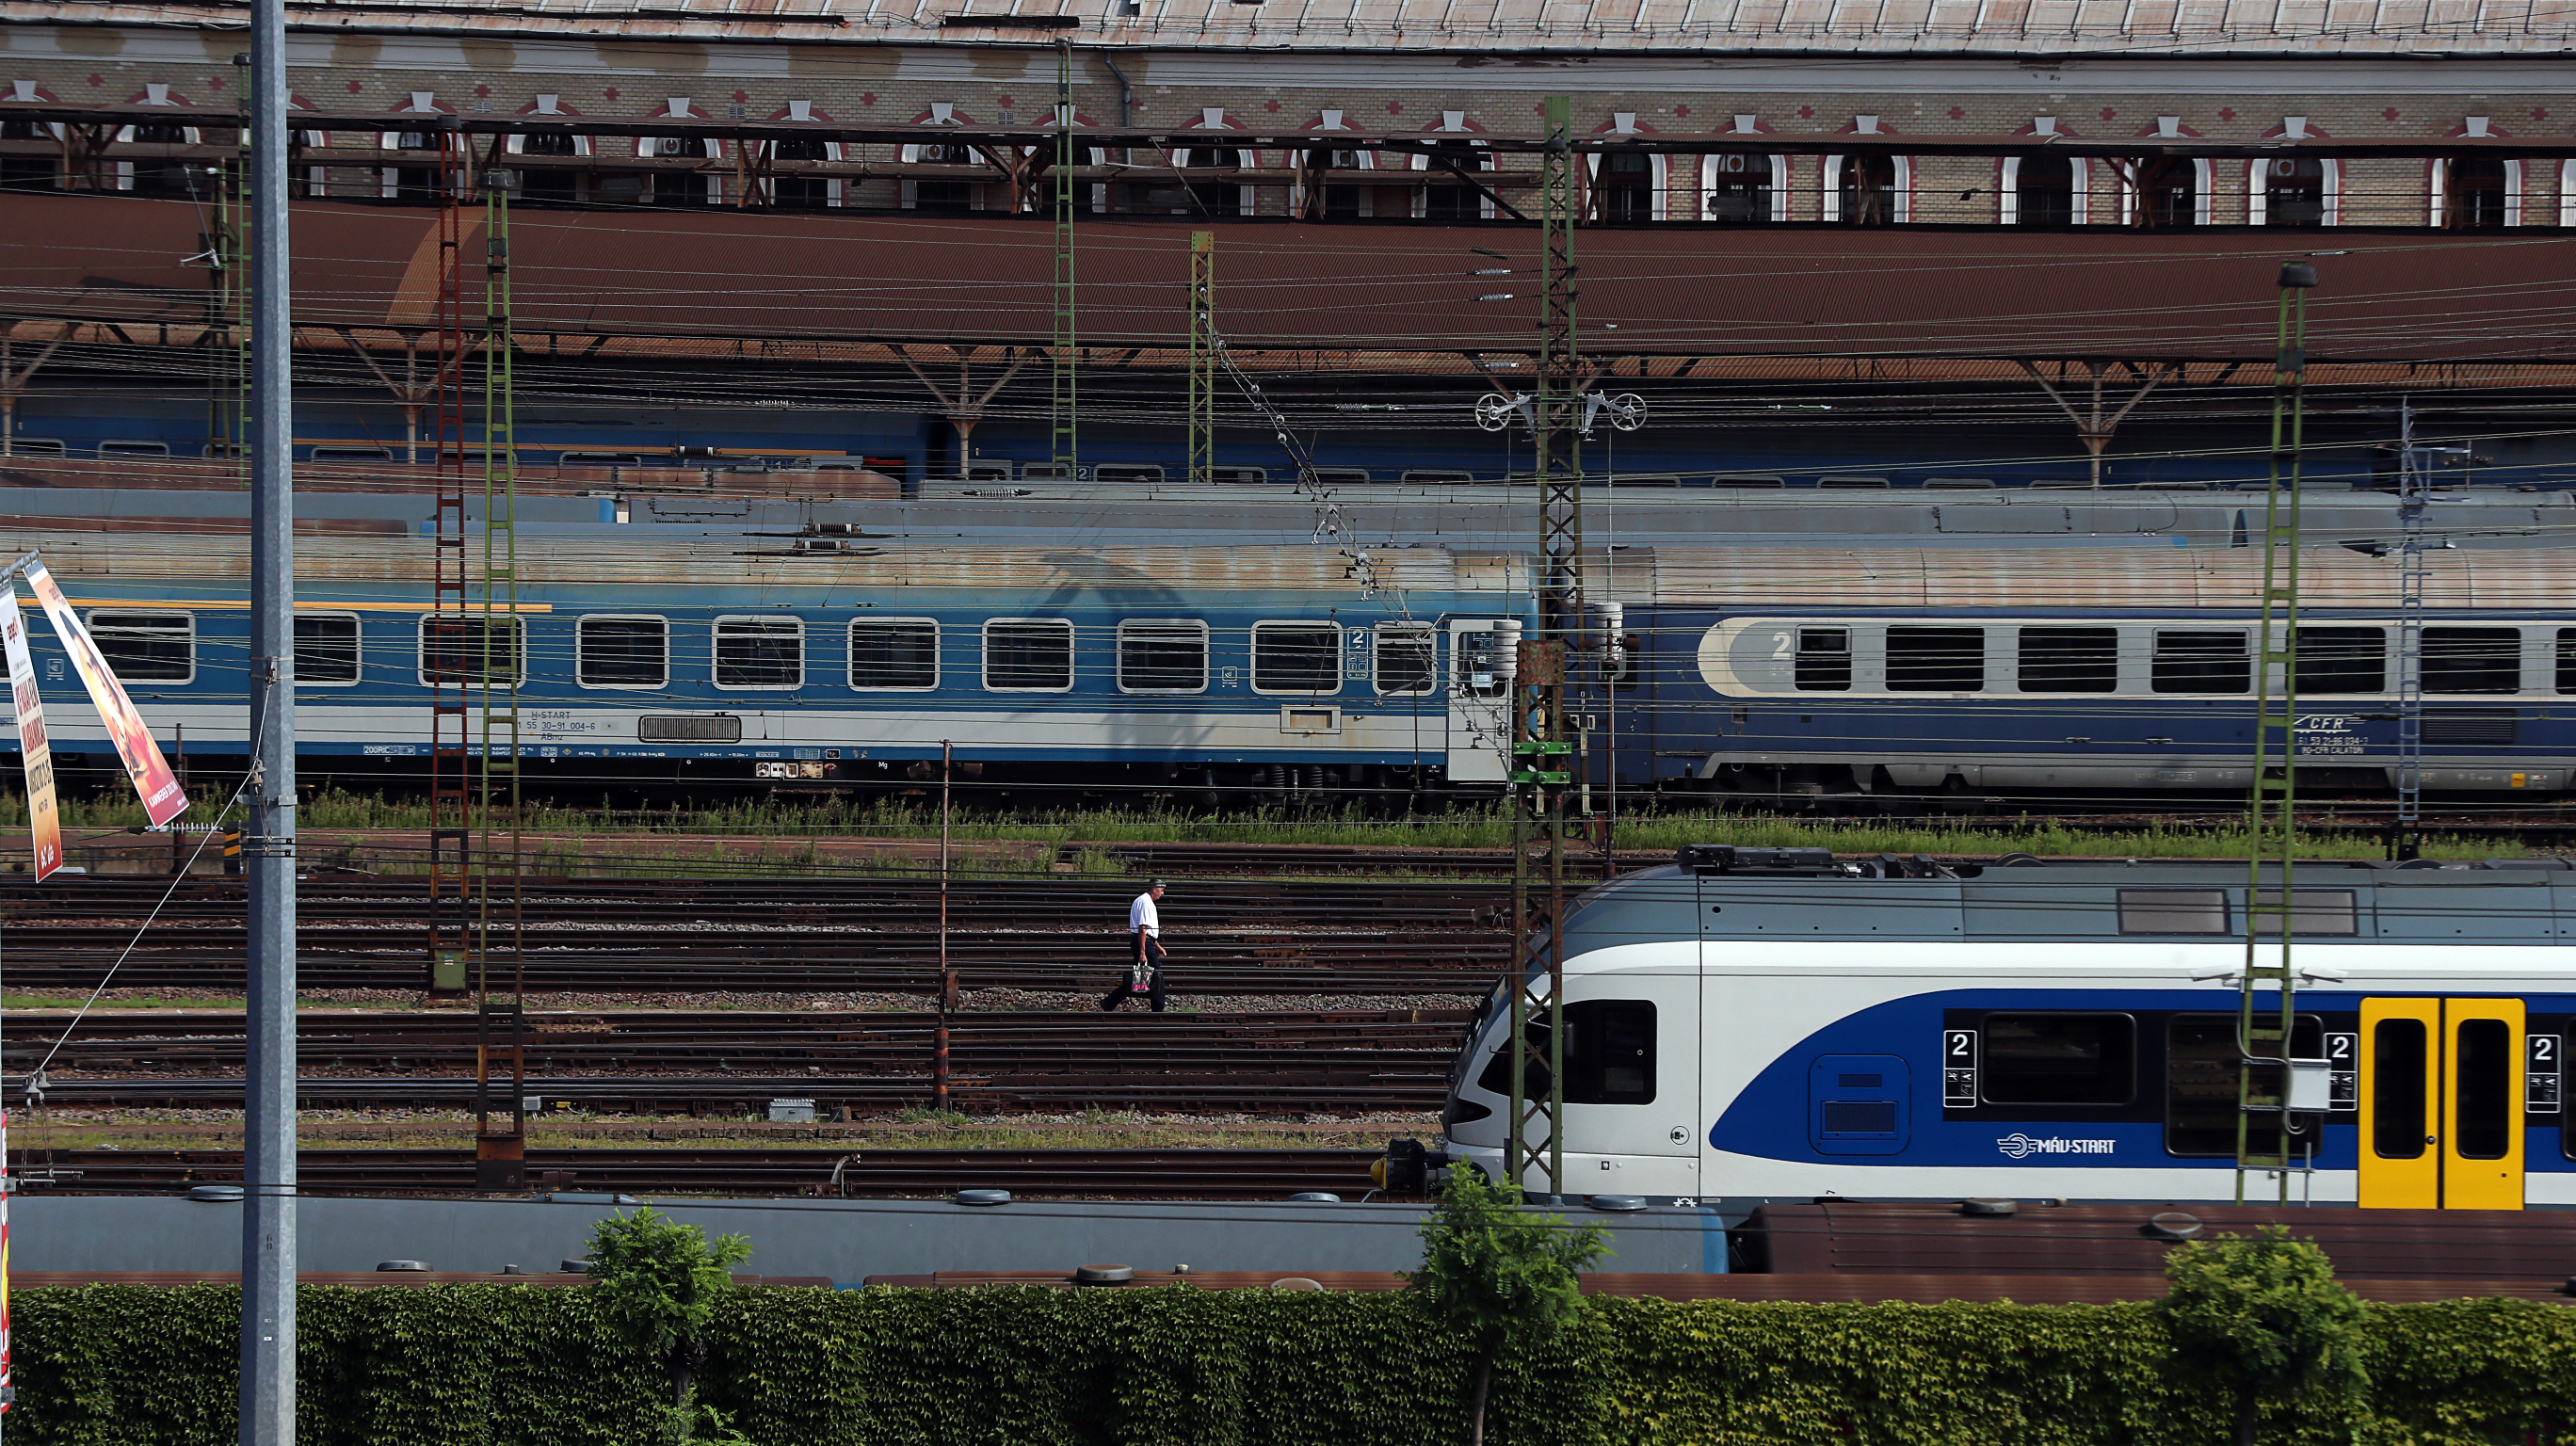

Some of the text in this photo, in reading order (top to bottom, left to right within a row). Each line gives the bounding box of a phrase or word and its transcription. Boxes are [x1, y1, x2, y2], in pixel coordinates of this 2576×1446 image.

[1078, 468, 1087, 480] 2
[1352, 628, 1364, 644] 2
[1771, 632, 1791, 660] 2
[531, 711, 571, 719] H-START
[526, 721, 538, 730] 55
[541, 722, 566, 731] 30-91
[570, 722, 596, 731] 004-6
[2310, 717, 2344, 730] CFR
[2310, 737, 2321, 746] 53
[877, 761, 888, 770] Mg
[1952, 1033, 1969, 1056] 2
[2331, 1036, 2349, 1059] 2
[2535, 1038, 2552, 1061] 2
[2037, 1135, 2117, 1154] MÁV-START
